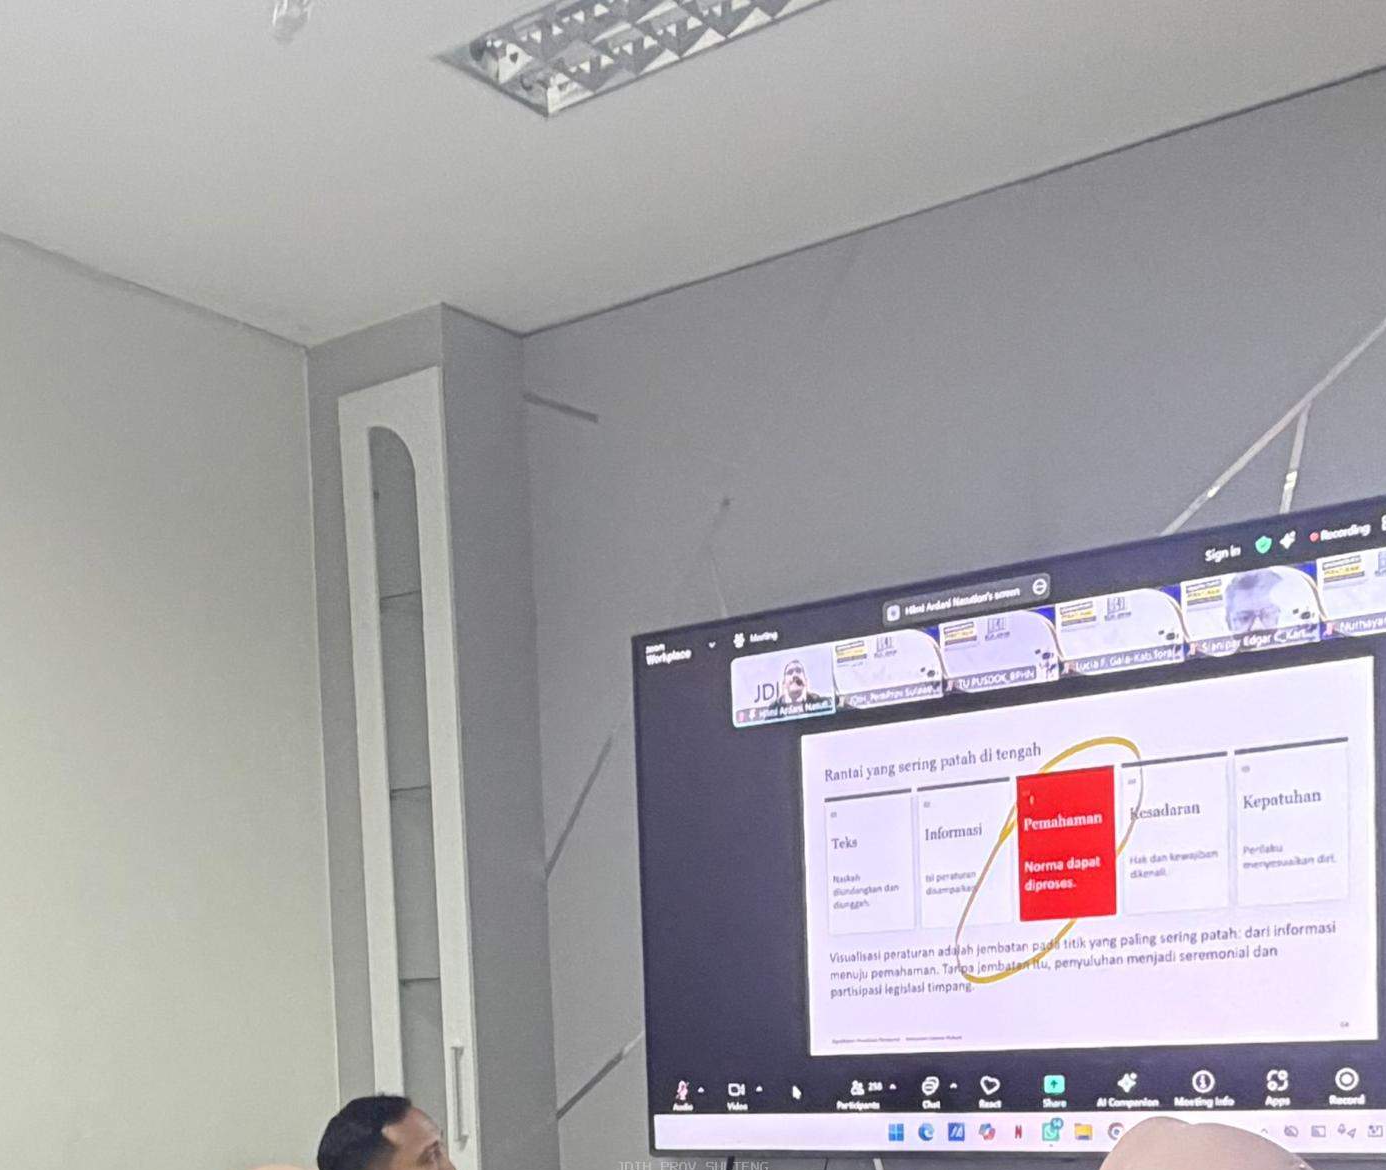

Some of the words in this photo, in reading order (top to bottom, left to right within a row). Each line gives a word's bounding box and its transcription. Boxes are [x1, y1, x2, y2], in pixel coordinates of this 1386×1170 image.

[1321, 523, 1371, 542] Recording
[1205, 549, 1228, 564] Sign
[825, 765, 863, 782] Rantai
[867, 762, 895, 779] yang
[899, 757, 936, 773] sering
[941, 750, 976, 770] patah
[996, 742, 1042, 762] tengah
[1243, 789, 1322, 810] Kepatuhan
[1130, 803, 1200, 820] Kesadaran
[1024, 813, 1103, 831] Pemahaman
[925, 823, 982, 840] Informasi
[831, 837, 858, 850] Teks
[1025, 860, 1063, 873] Norma
[1067, 856, 1100, 872] dapat
[936, 870, 976, 884] peraturan
[1025, 878, 1076, 893] diproses.
[829, 952, 881, 964] Visualisasi
[884, 947, 935, 962] peraturan
[938, 944, 974, 957] adalah
[976, 941, 1029, 957] jembatan
[1032, 939, 1060, 954] pada
[1063, 937, 1086, 949] titik
[1089, 937, 1117, 951] yang
[1120, 933, 1156, 949] paling
[1160, 930, 1197, 946] sering
[1201, 927, 1241, 943] patah:
[1245, 925, 1270, 939] dari
[1273, 921, 1336, 937] informasi
[830, 968, 868, 982] menuju
[871, 966, 939, 981] pemahaman.
[943, 962, 974, 977] Tanpa
[977, 959, 1029, 975] jembatan
[1032, 958, 1051, 971] itu,
[1054, 953, 1123, 970] penyuluhan
[1127, 951, 1176, 967] menjadi
[1179, 946, 1249, 961] seremonial
[1253, 945, 1278, 958] dan
[830, 984, 882, 999] partisipasi
[885, 983, 925, 997] legislasi
[928, 980, 975, 994] timpang.
[836, 1100, 880, 1111] Participants
[979, 1099, 1002, 1109] React
[1043, 1098, 1067, 1109] Share
[1108, 1097, 1159, 1109] Companion
[1174, 1096, 1213, 1109] Meeting
[1265, 1096, 1290, 1107] Apps
[1329, 1095, 1365, 1106] Record
